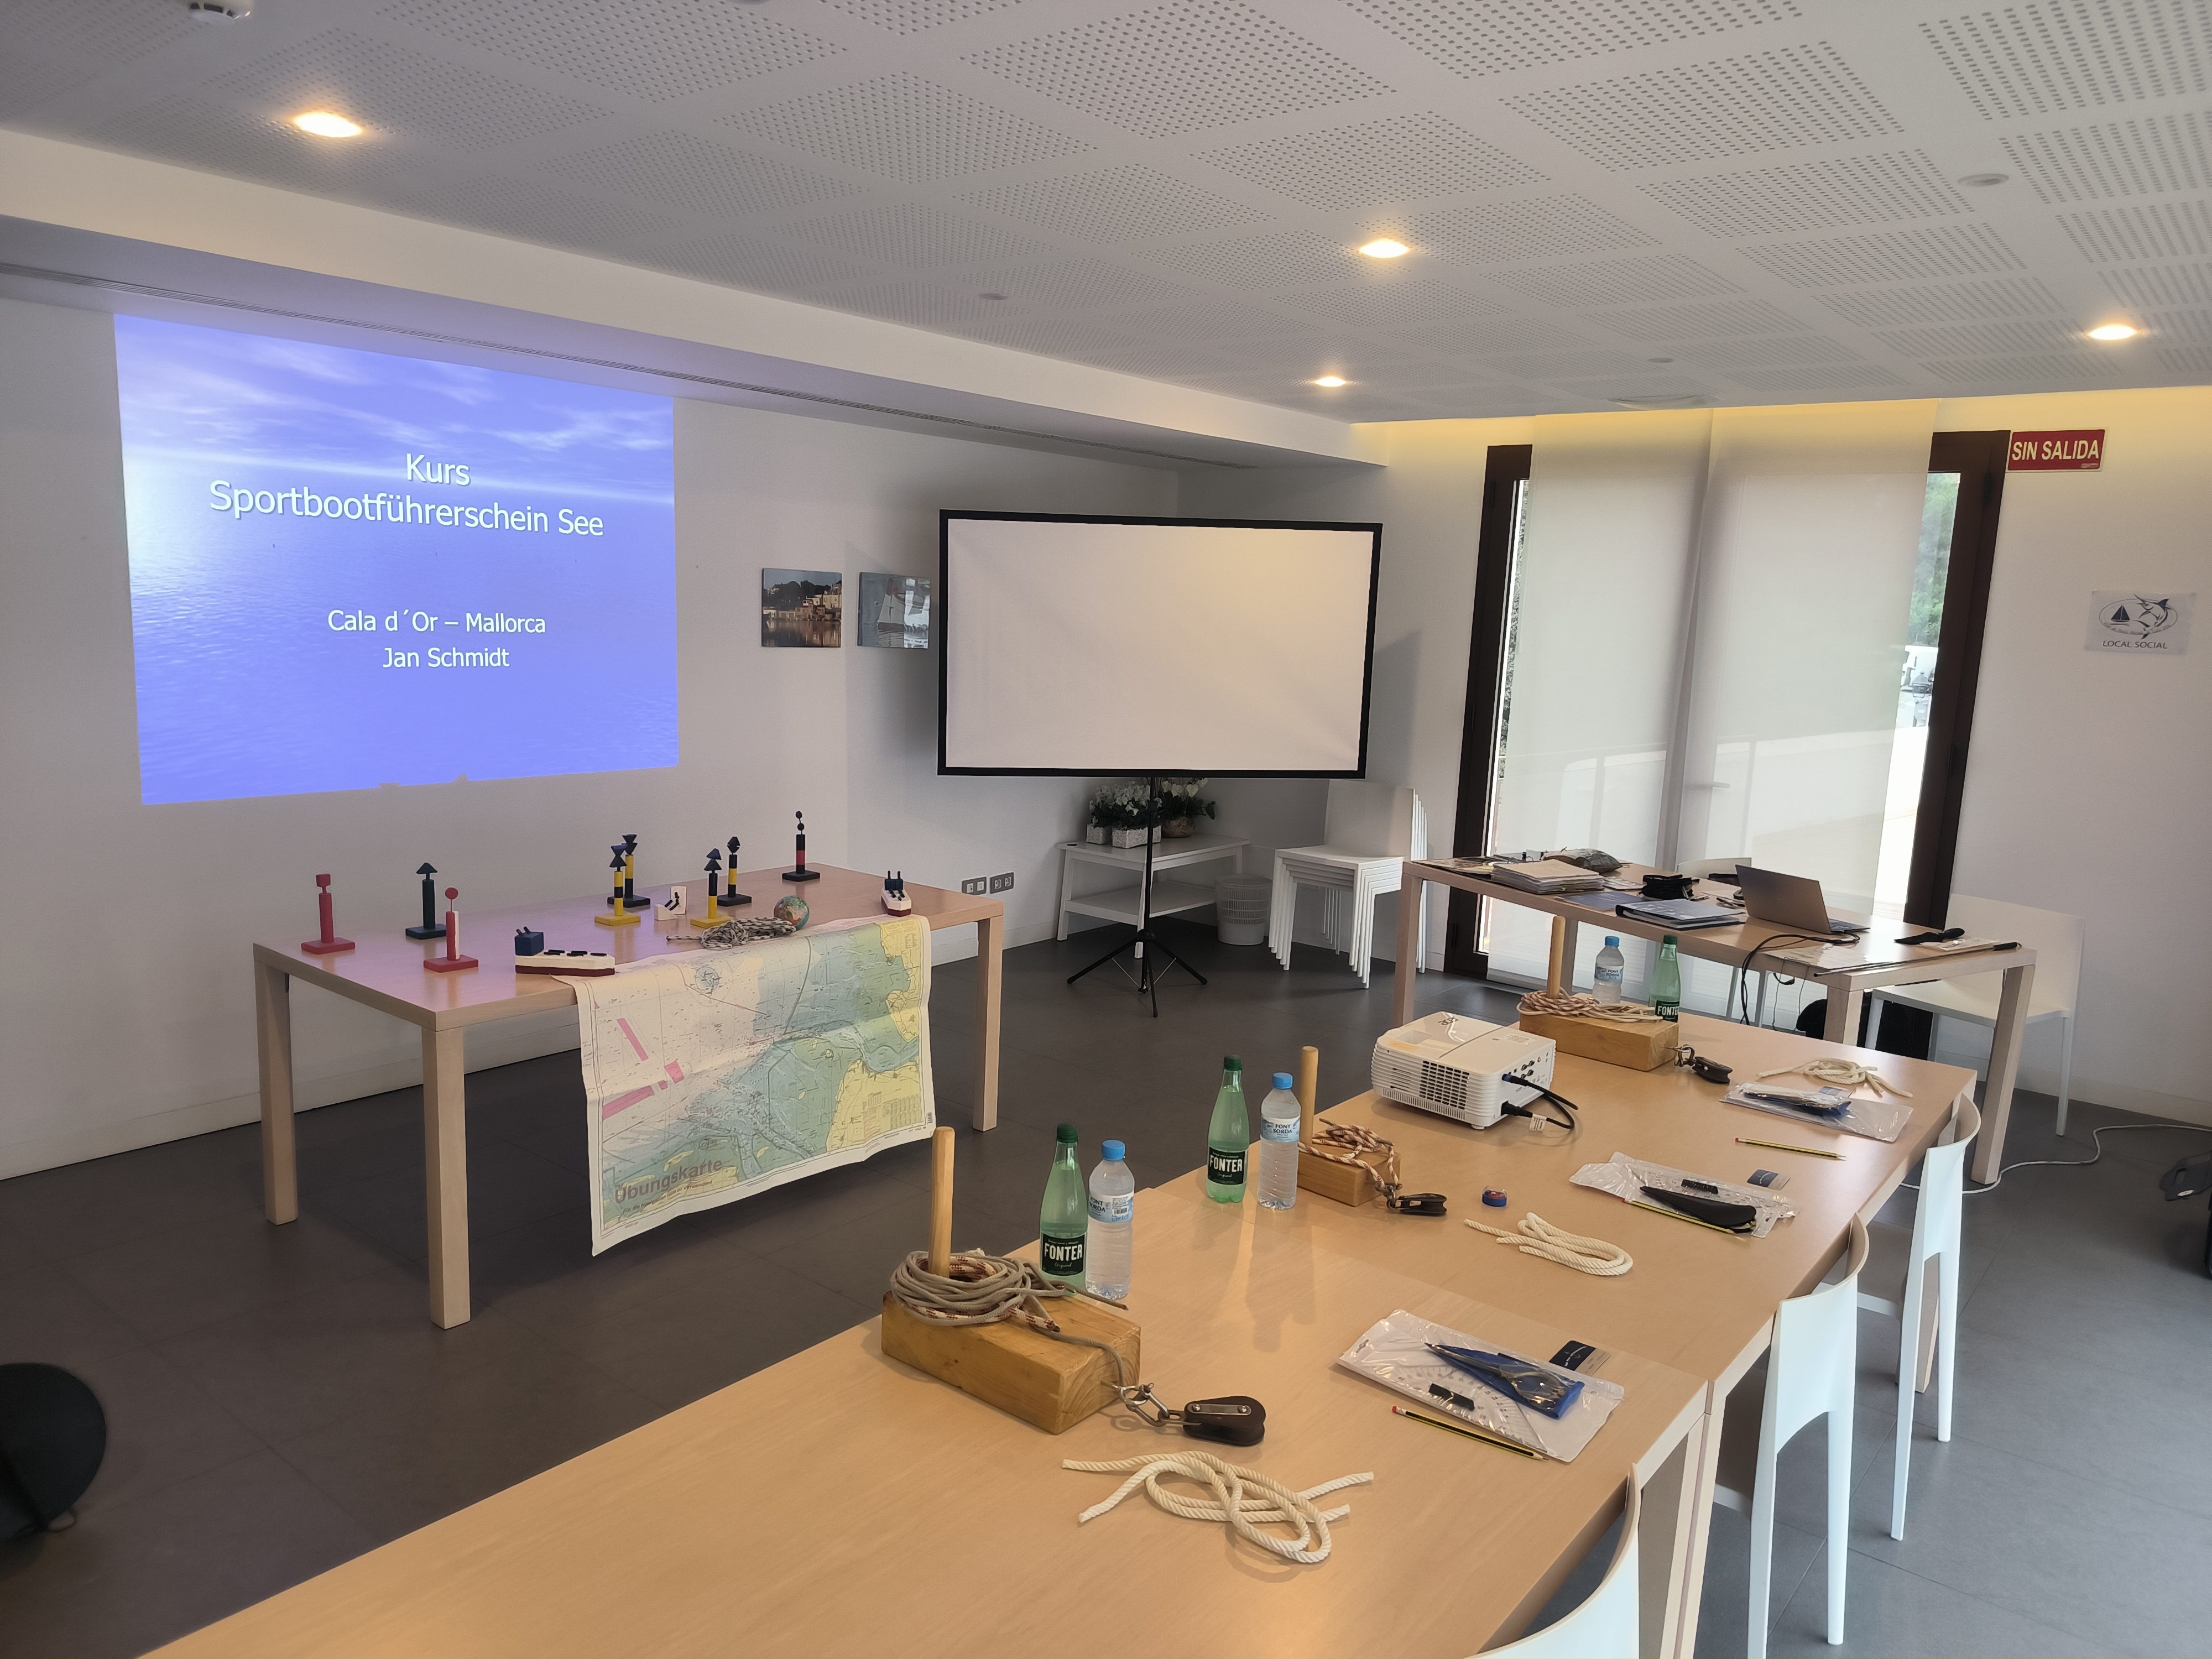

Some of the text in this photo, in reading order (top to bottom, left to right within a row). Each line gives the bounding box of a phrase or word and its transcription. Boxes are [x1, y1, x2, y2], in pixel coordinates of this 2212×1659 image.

[2012, 440, 2099, 461] SIN SALIDA
[405, 452, 471, 486] Kurs
[210, 479, 604, 536] Sportbootführerschein See
[327, 609, 377, 632] Cala
[466, 612, 546, 634] Mallorca
[383, 646, 510, 668] Jan Schmidt
[1657, 1005, 1679, 1016] FONTE
[1210, 1155, 1243, 1172] FONTER
[615, 1160, 723, 1204] Übungskarte
[1044, 1243, 1083, 1261] FONTER
